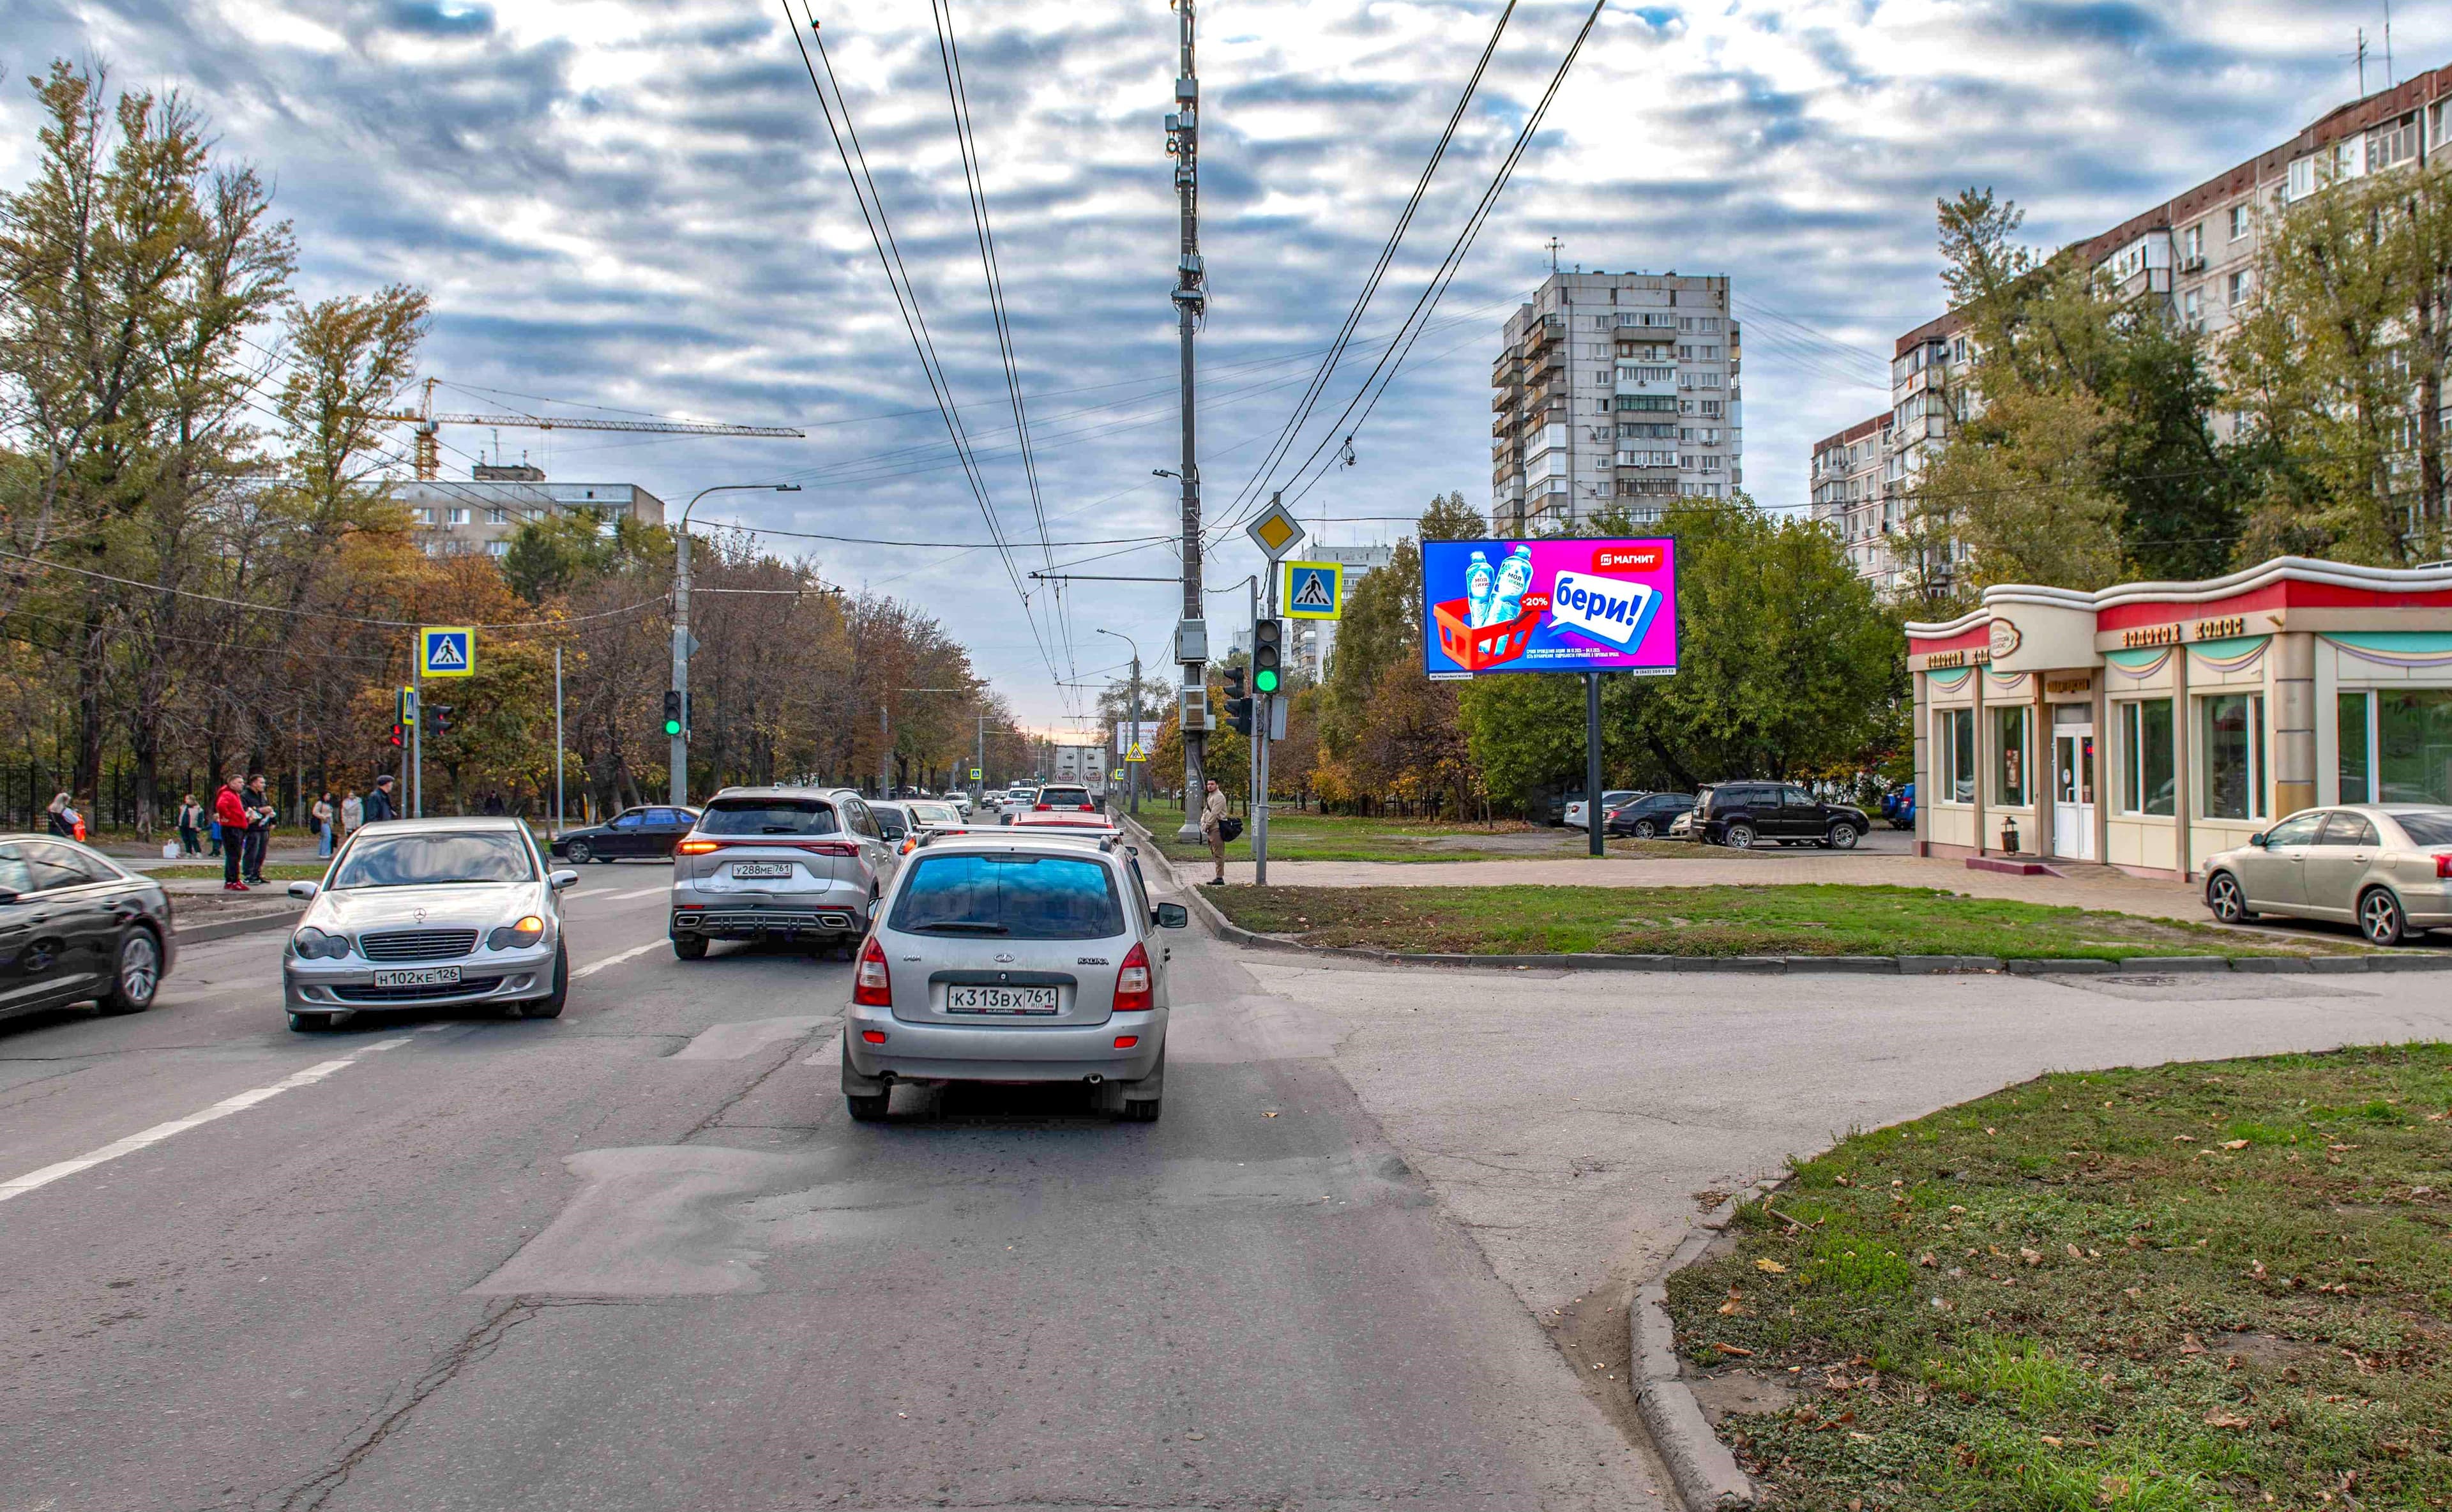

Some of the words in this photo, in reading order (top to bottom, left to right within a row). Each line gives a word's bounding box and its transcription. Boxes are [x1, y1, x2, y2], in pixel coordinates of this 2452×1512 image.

[1614, 555, 1655, 564] МАГНИТ
[1508, 572, 1522, 582] МОЯ
[1522, 597, 1548, 606] -20%
[1556, 577, 1643, 626] бери!
[2121, 623, 2181, 648] ЗОЛОТОЙ
[2193, 617, 2243, 640] КОЛОС
[1972, 648, 1990, 664] КОЛ
[736, 865, 773, 875] У288МЕ
[1078, 957, 1109, 965] KALINA
[380, 972, 434, 985] Н102КЕ
[436, 969, 458, 978] 126
[955, 989, 1022, 1007] К313ВХ
[1026, 990, 1052, 1004] 761
